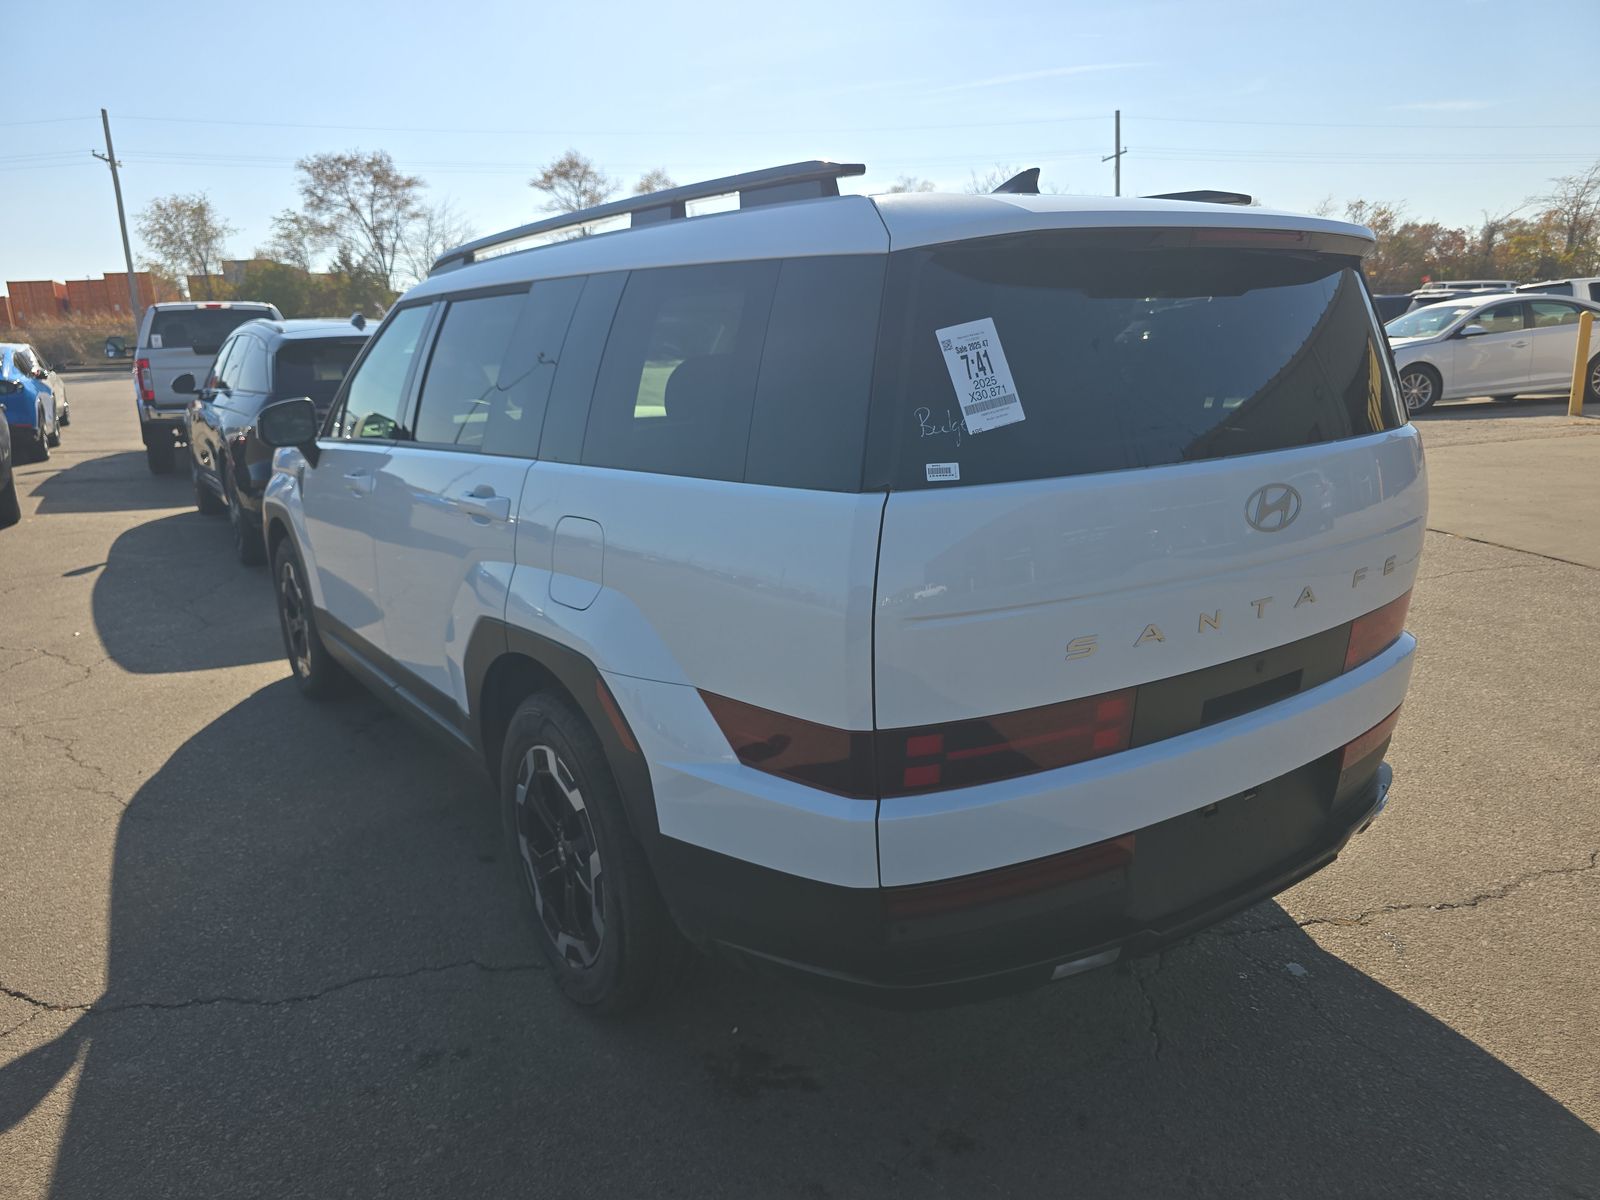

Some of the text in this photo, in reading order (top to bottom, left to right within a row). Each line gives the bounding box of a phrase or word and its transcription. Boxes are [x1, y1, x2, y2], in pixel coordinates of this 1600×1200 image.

[955, 345, 968, 354] Sale
[967, 341, 981, 351] 2025
[982, 339, 989, 347] 47
[960, 349, 994, 380] 7:41
[973, 376, 998, 390] 2025
[968, 385, 1007, 403] X30,871
[1065, 555, 1396, 660] SANTA FE
